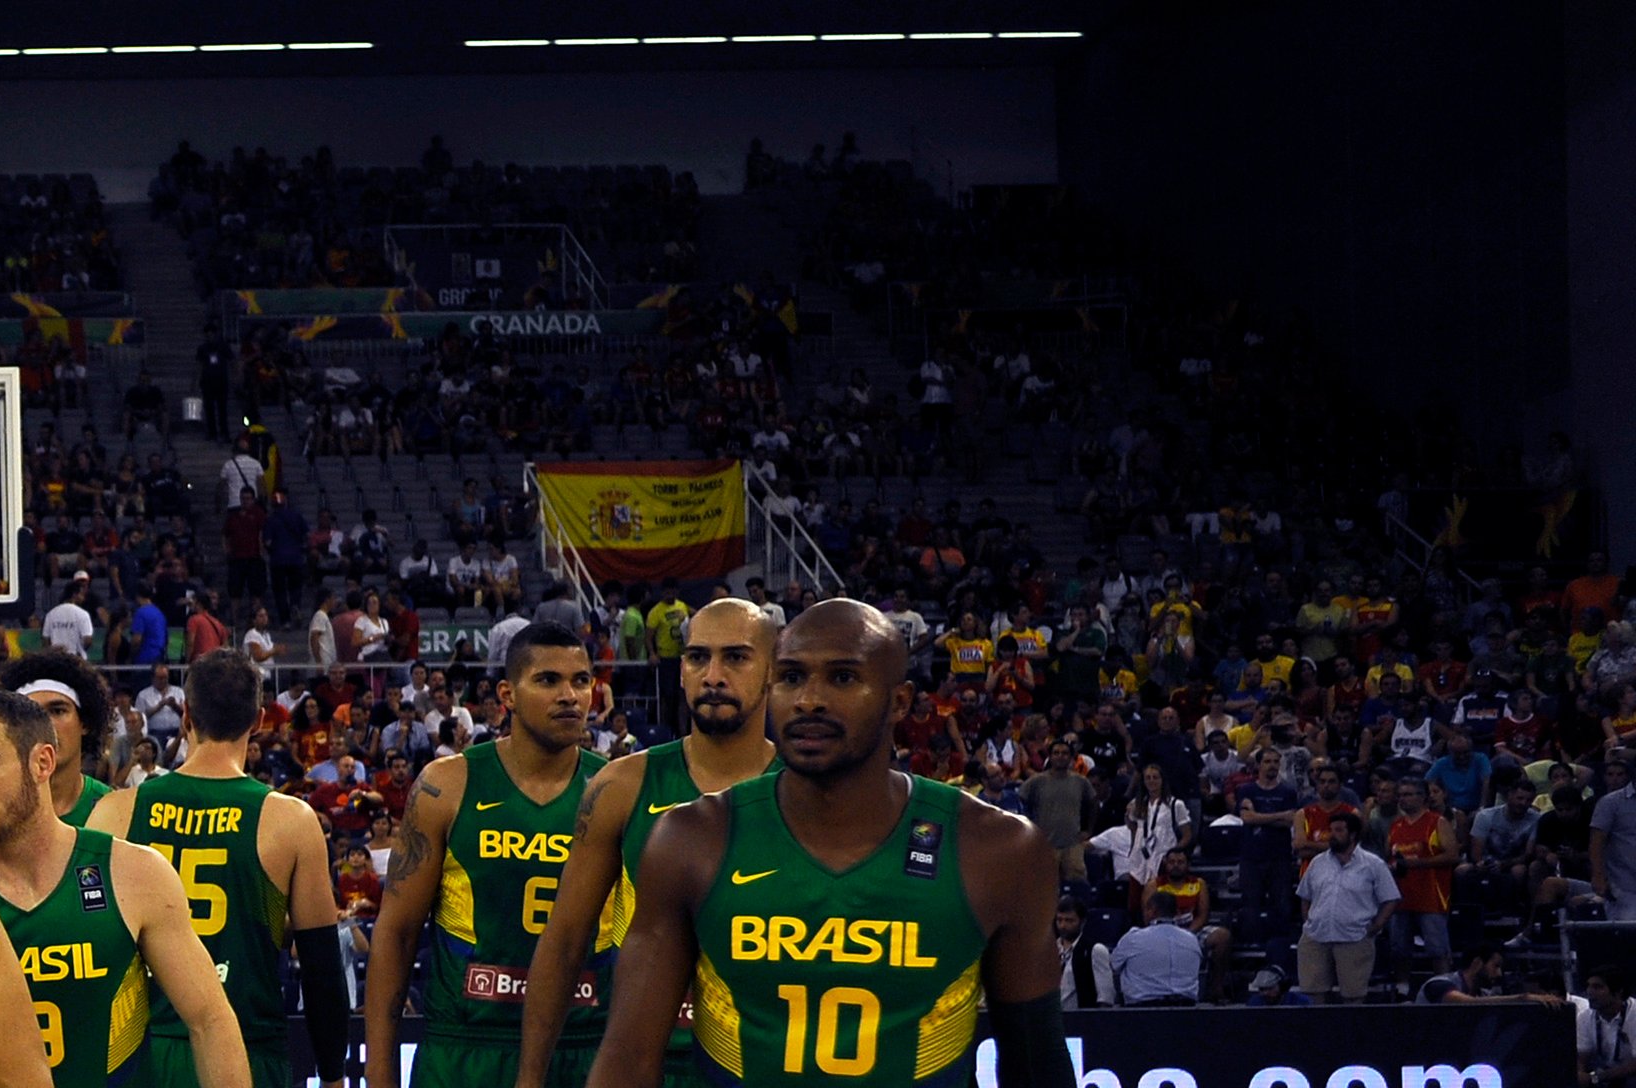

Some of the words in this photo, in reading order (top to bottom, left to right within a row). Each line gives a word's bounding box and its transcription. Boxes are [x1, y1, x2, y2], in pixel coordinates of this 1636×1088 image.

[149, 802, 242, 836] SPLITTER
[479, 829, 573, 863] BRAS
[910, 851, 933, 864] FIBA
[730, 915, 938, 968] BRASIL
[20, 942, 108, 982] ASIL
[777, 983, 882, 1077] 10
